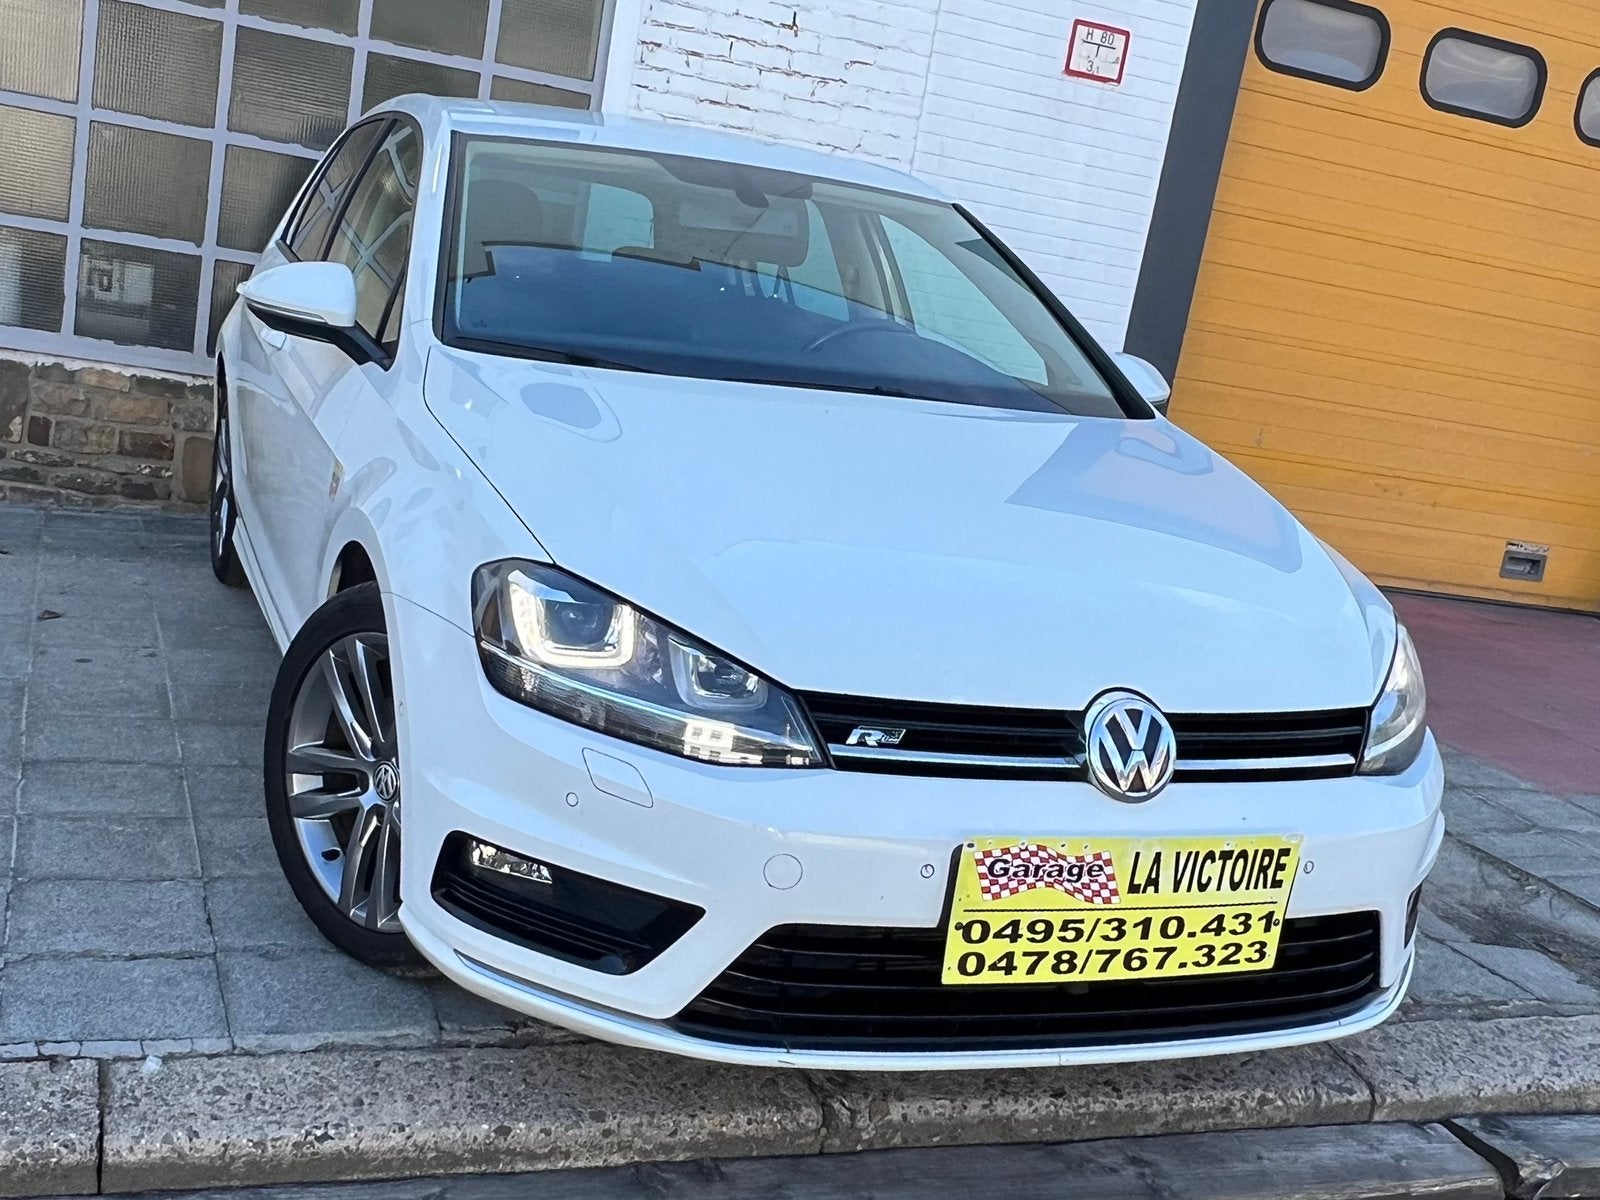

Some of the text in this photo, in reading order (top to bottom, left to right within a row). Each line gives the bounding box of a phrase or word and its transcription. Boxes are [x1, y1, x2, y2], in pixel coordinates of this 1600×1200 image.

[1086, 28, 1115, 45] H 80
[987, 848, 1291, 894] Garage LA VICTOIRE
[961, 911, 1276, 944] 0495/310.431
[957, 940, 1268, 976] 0478/767.323
